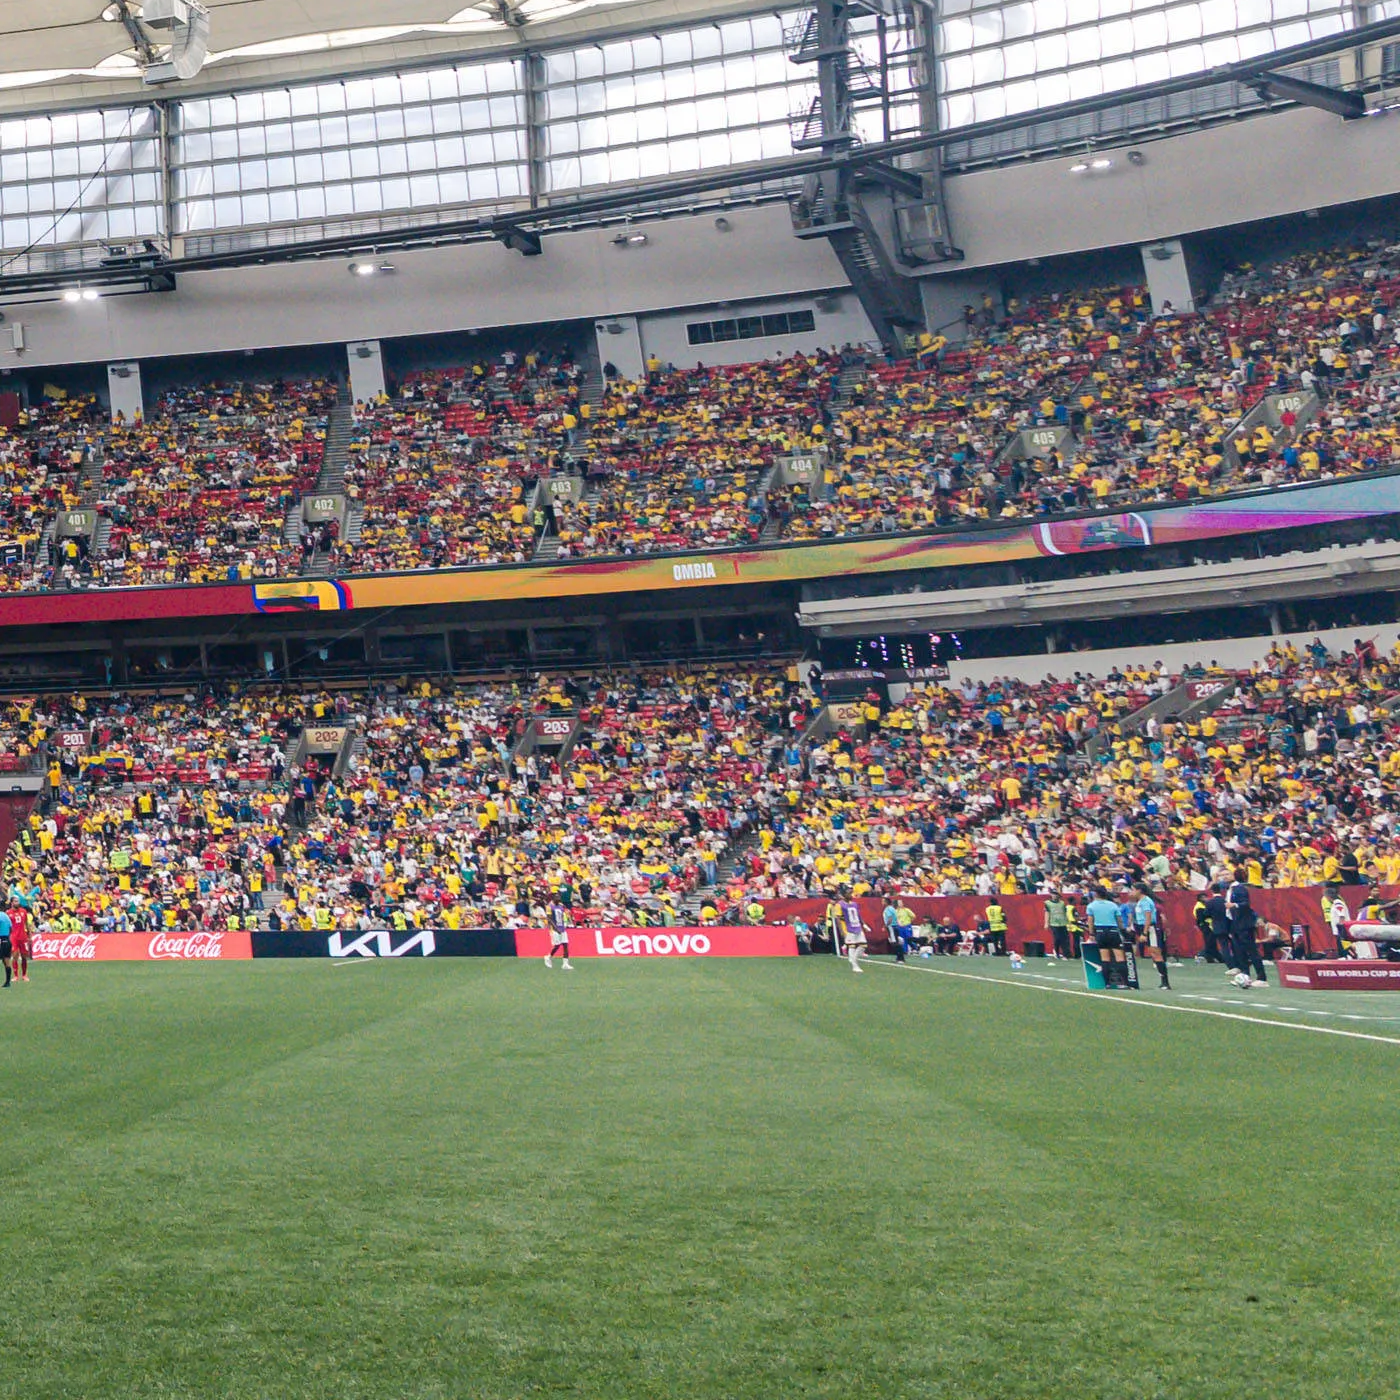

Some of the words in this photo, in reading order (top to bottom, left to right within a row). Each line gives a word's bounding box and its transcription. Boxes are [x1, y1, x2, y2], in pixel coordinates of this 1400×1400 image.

[1032, 432, 1056, 446] 405
[791, 459, 813, 472] 404
[551, 481, 572, 493] 403
[315, 499, 334, 511] 402
[68, 514, 86, 525] 401
[672, 562, 717, 580] OMBIA
[544, 721, 570, 734] 203
[63, 733, 86, 746] 201
[315, 732, 339, 743] 202
[148, 932, 225, 958] Coca-Cola
[328, 931, 436, 957] KIA
[596, 931, 711, 955] Lenovo
